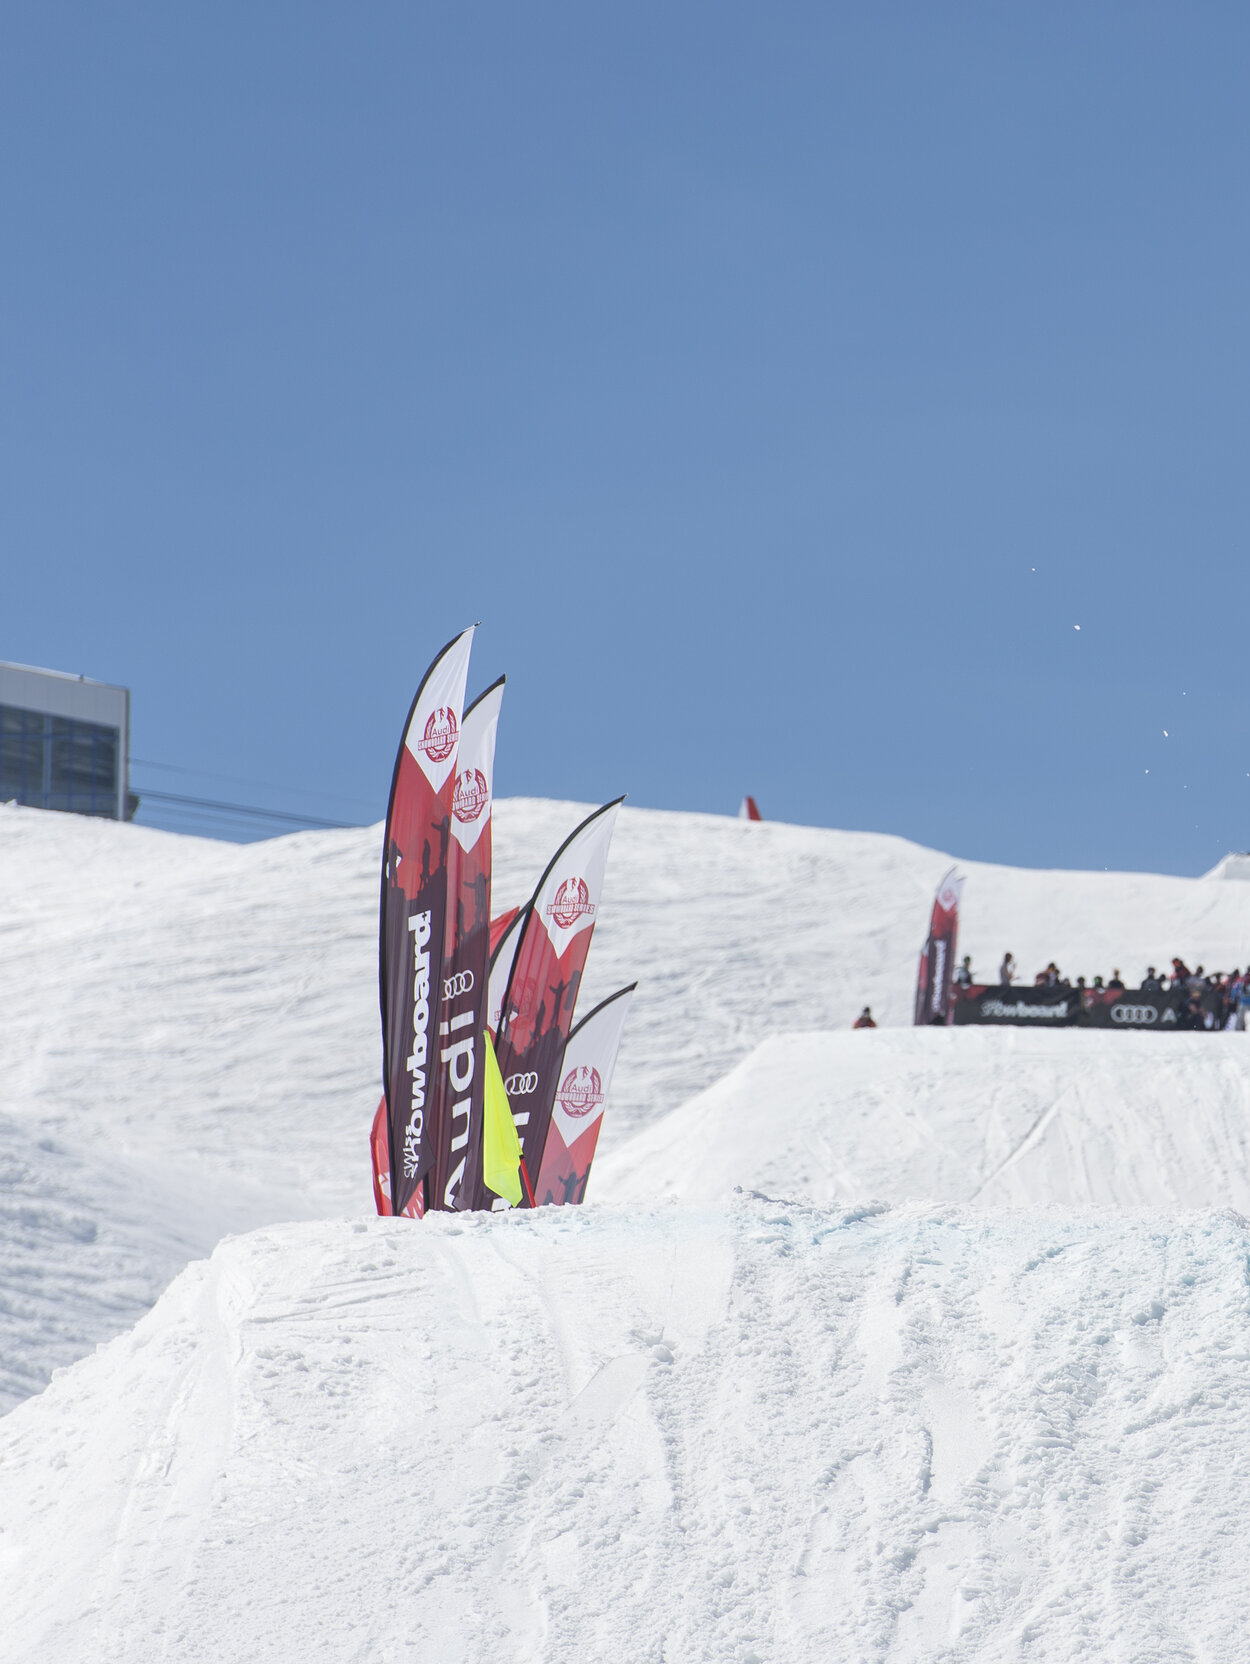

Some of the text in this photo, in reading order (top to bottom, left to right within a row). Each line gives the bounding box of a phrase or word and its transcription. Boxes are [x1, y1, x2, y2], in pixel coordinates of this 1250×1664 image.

[432, 726, 450, 736] Audi
[460, 787, 478, 797] Audi
[571, 1084, 591, 1092] Audi
[439, 1010, 474, 1209] Audi
